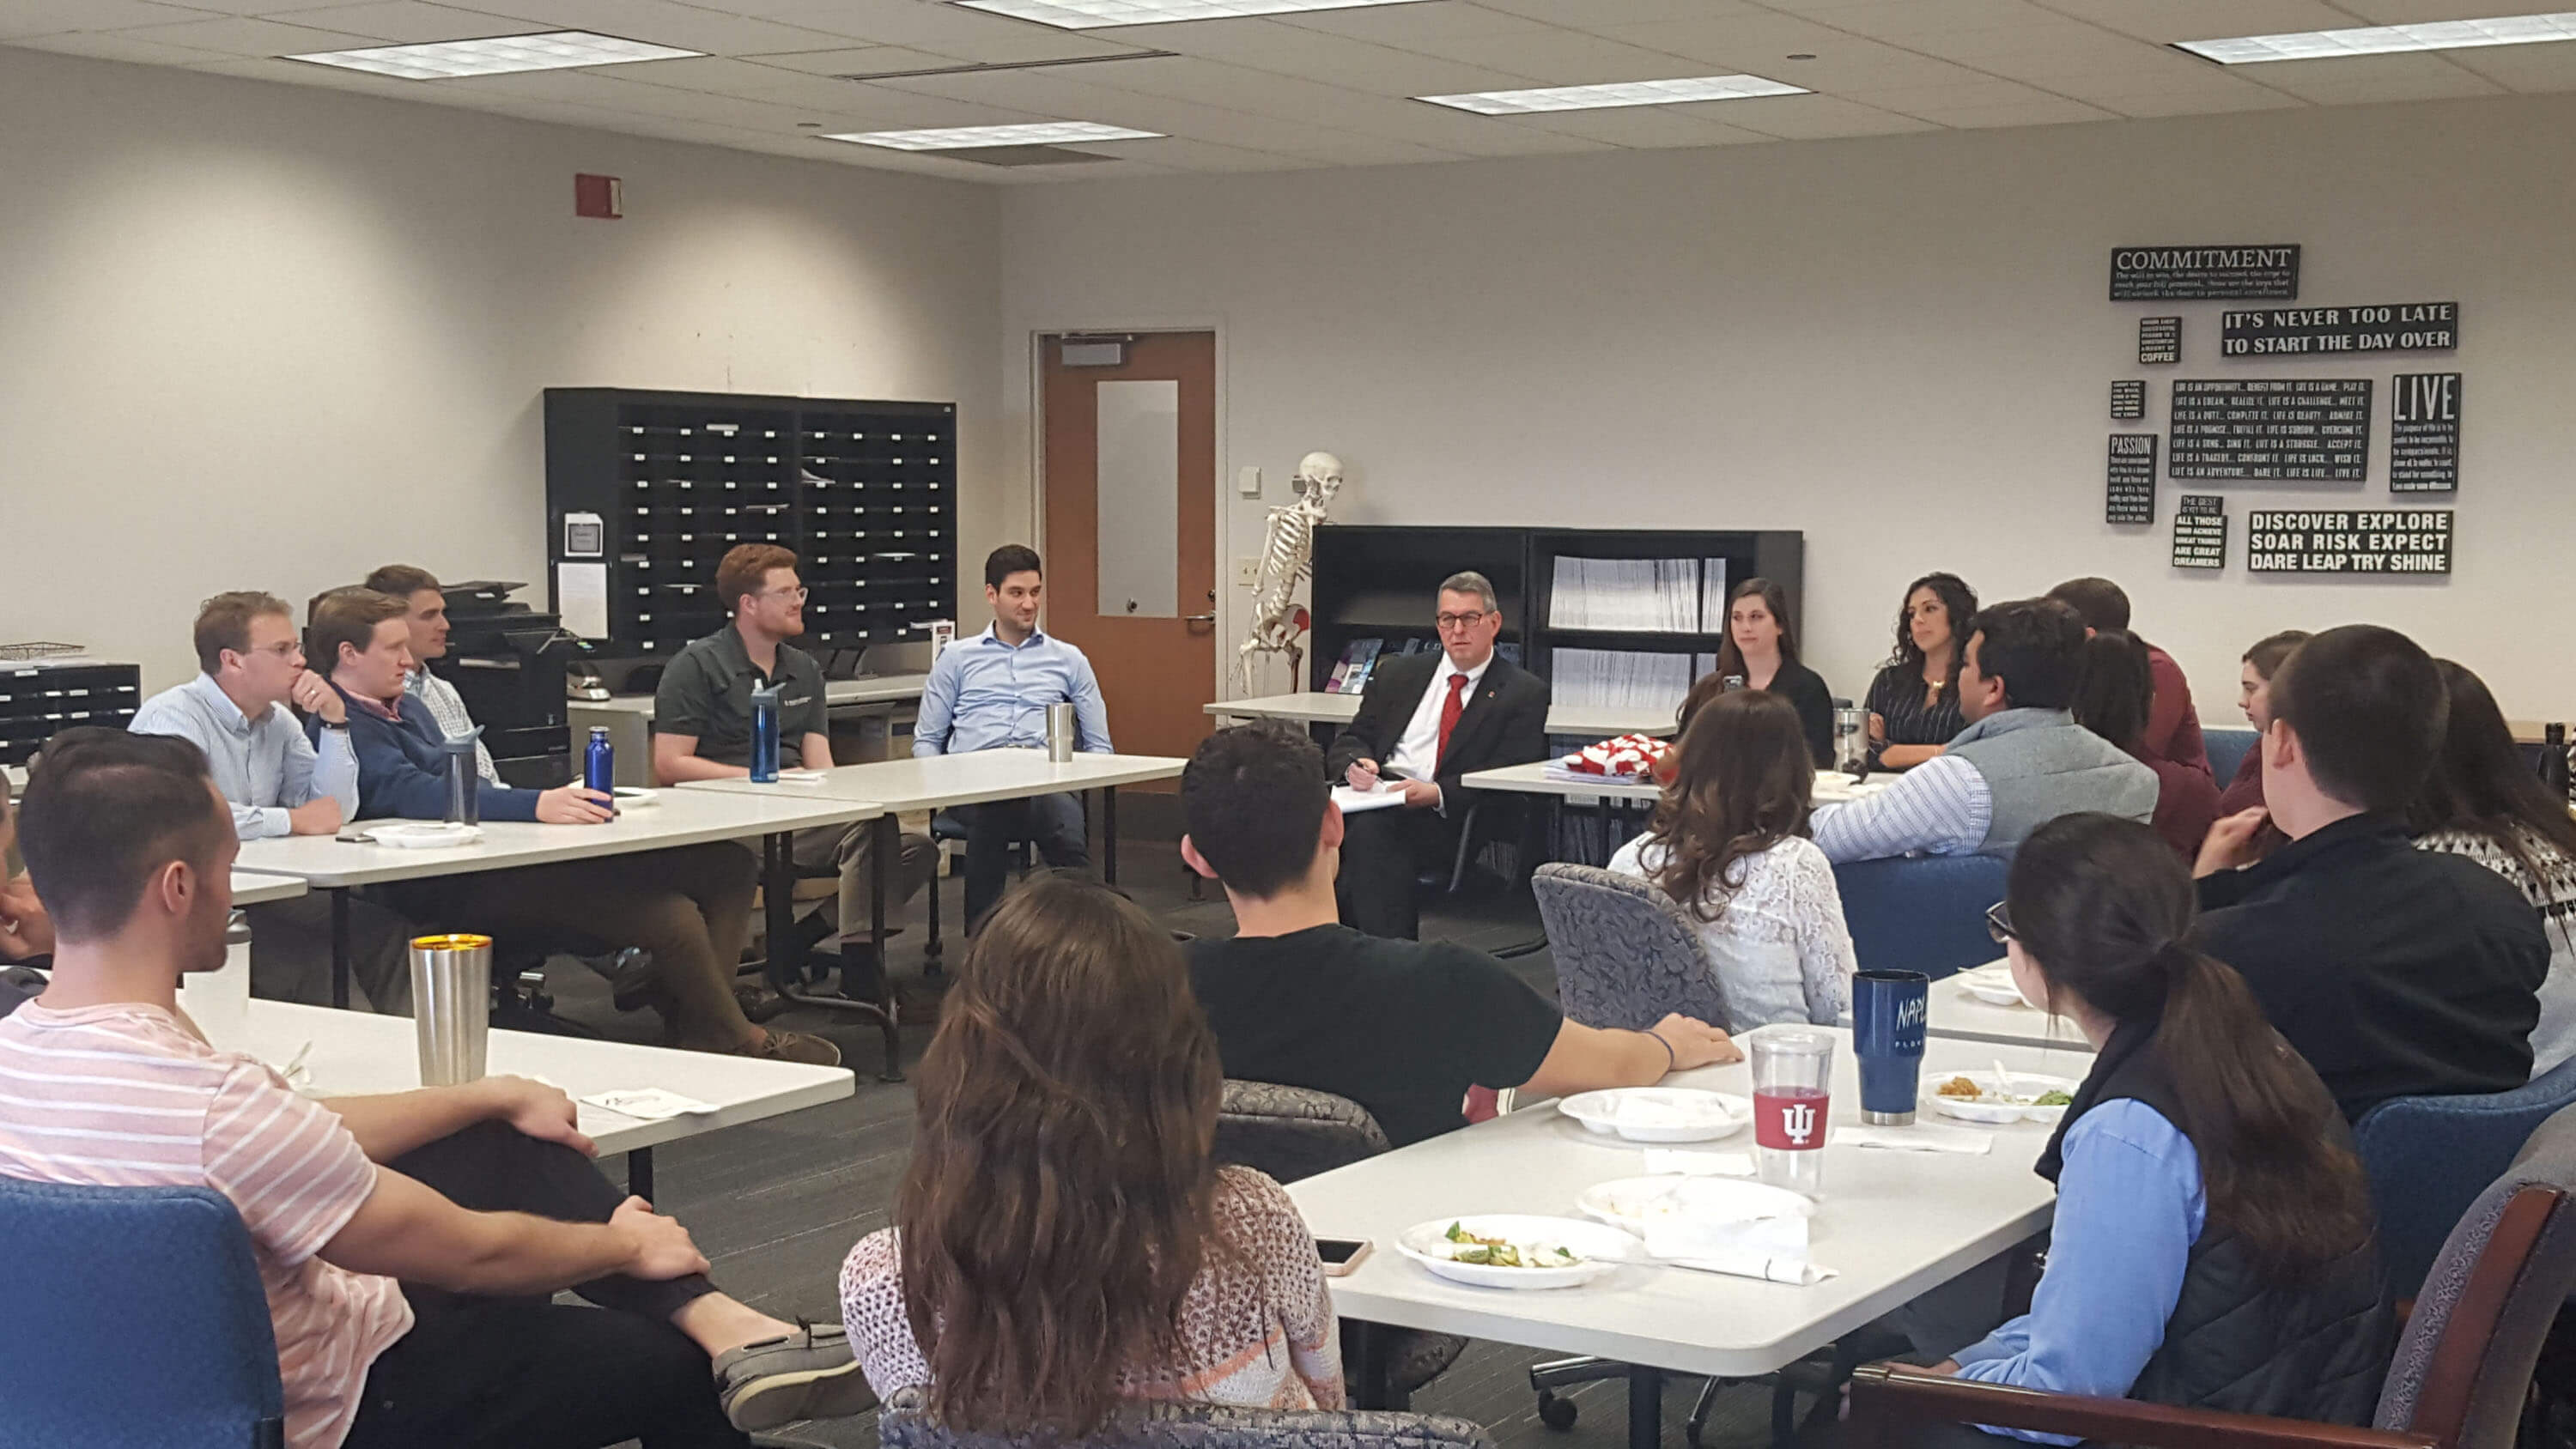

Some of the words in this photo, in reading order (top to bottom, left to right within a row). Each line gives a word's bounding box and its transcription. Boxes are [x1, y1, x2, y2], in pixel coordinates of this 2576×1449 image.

[2117, 249, 2291, 270] COMMITMENT
[2225, 313, 2264, 329] IT'S
[2274, 310, 2339, 327] NEVER
[2349, 307, 2391, 324] TOO
[2401, 305, 2451, 322] LATE
[2224, 338, 2248, 354] TO
[2254, 336, 2312, 353] START
[2318, 334, 2353, 351] THE
[2359, 333, 2395, 349] DAY
[2400, 331, 2451, 348] OVER
[2142, 353, 2174, 361] COFFEE
[2394, 375, 2455, 421] LIVE
[2111, 437, 2150, 454] PASSION
[2177, 516, 2193, 524] ALL
[2195, 517, 2222, 525] THOSE
[2252, 513, 2348, 530] DISCOVER
[2357, 513, 2447, 530] EXPLORE
[2251, 534, 2304, 549] SOAR
[2313, 534, 2360, 549] RISK
[2369, 534, 2447, 549] EXPECT
[2175, 546, 2192, 555] ARE
[2193, 546, 2221, 556] GREAT
[2174, 557, 2220, 567] DREAMERS
[2251, 554, 2298, 570] DARE
[2303, 554, 2348, 570] LEAP
[2350, 554, 2385, 570] TRY
[2390, 554, 2445, 570] SHINE
